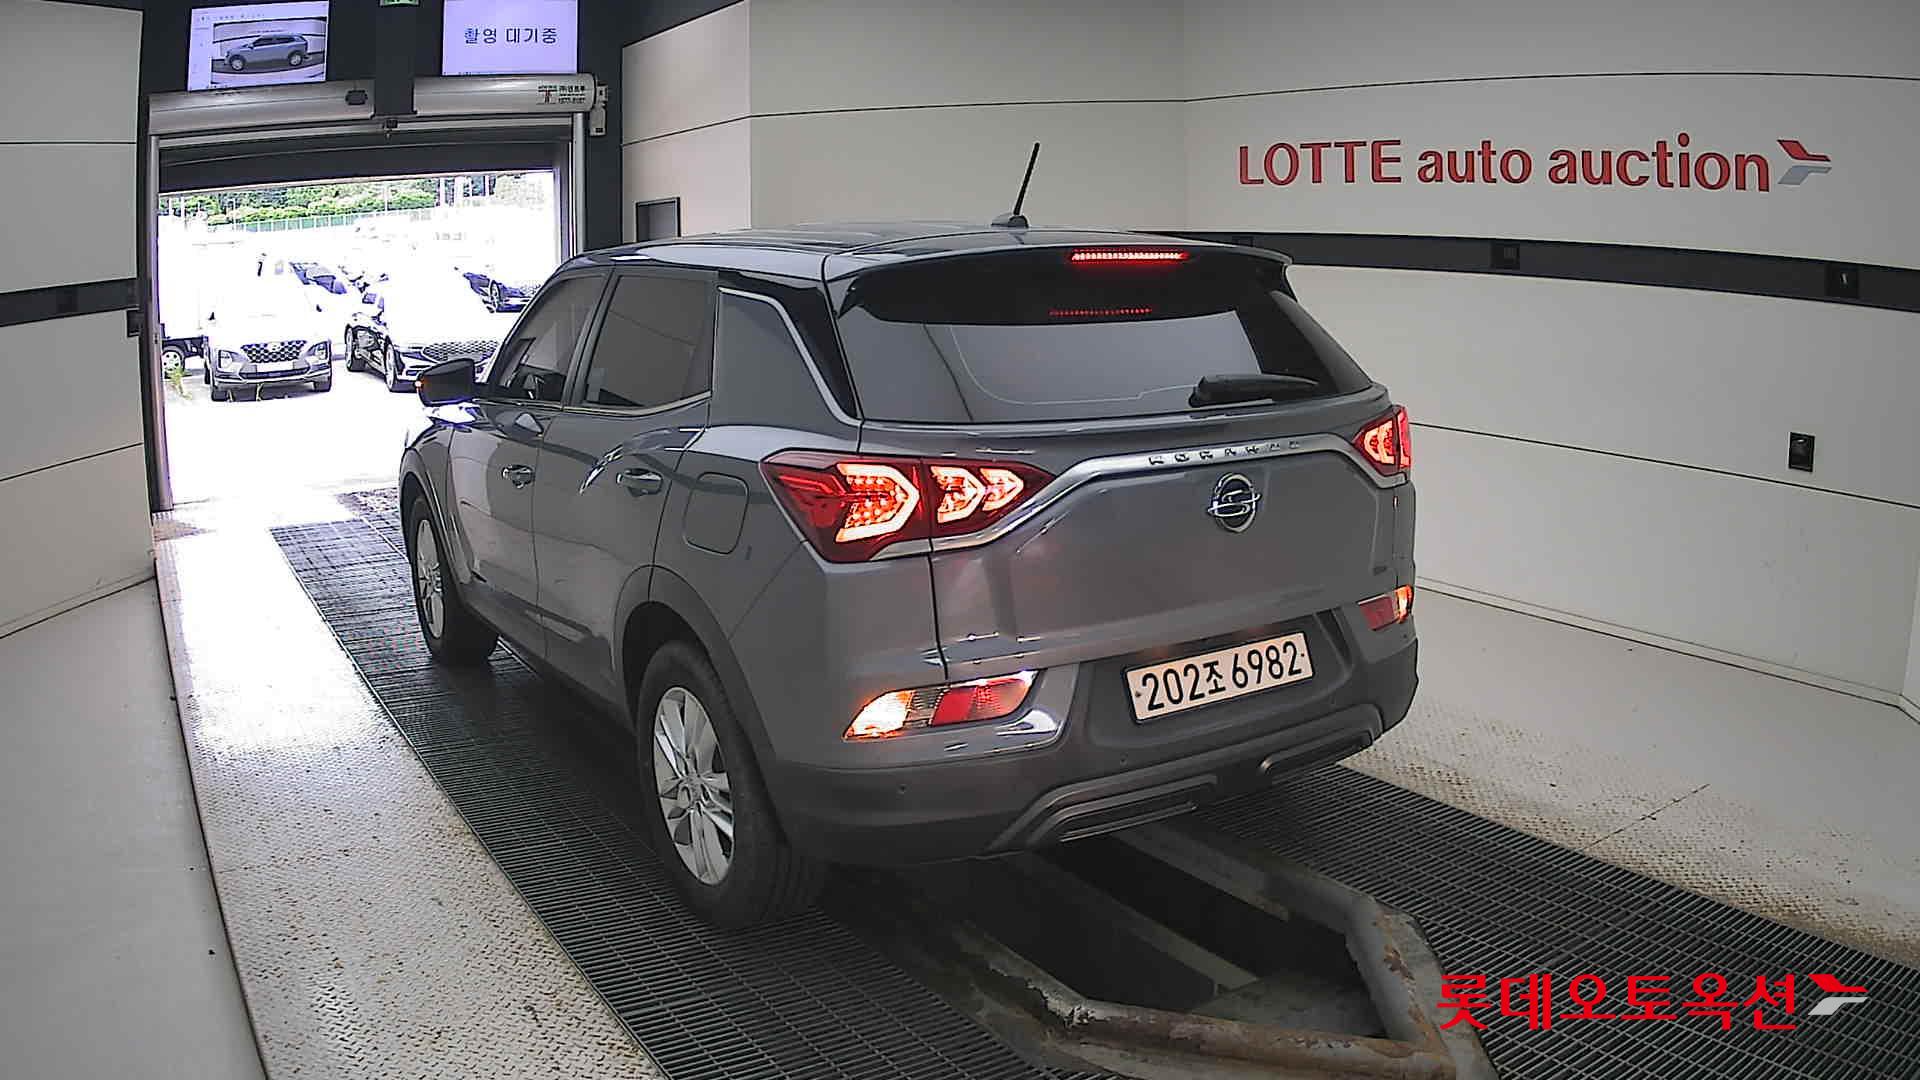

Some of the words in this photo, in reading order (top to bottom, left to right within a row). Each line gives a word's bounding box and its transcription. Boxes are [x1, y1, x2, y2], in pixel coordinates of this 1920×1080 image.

[464, 27, 497, 44] 촬영
[504, 27, 558, 44] 대기중
[1238, 139, 1402, 184] LOTTE
[1416, 141, 1533, 184] auto
[1549, 132, 1770, 191] auction
[1232, 641, 1302, 688] 6982
